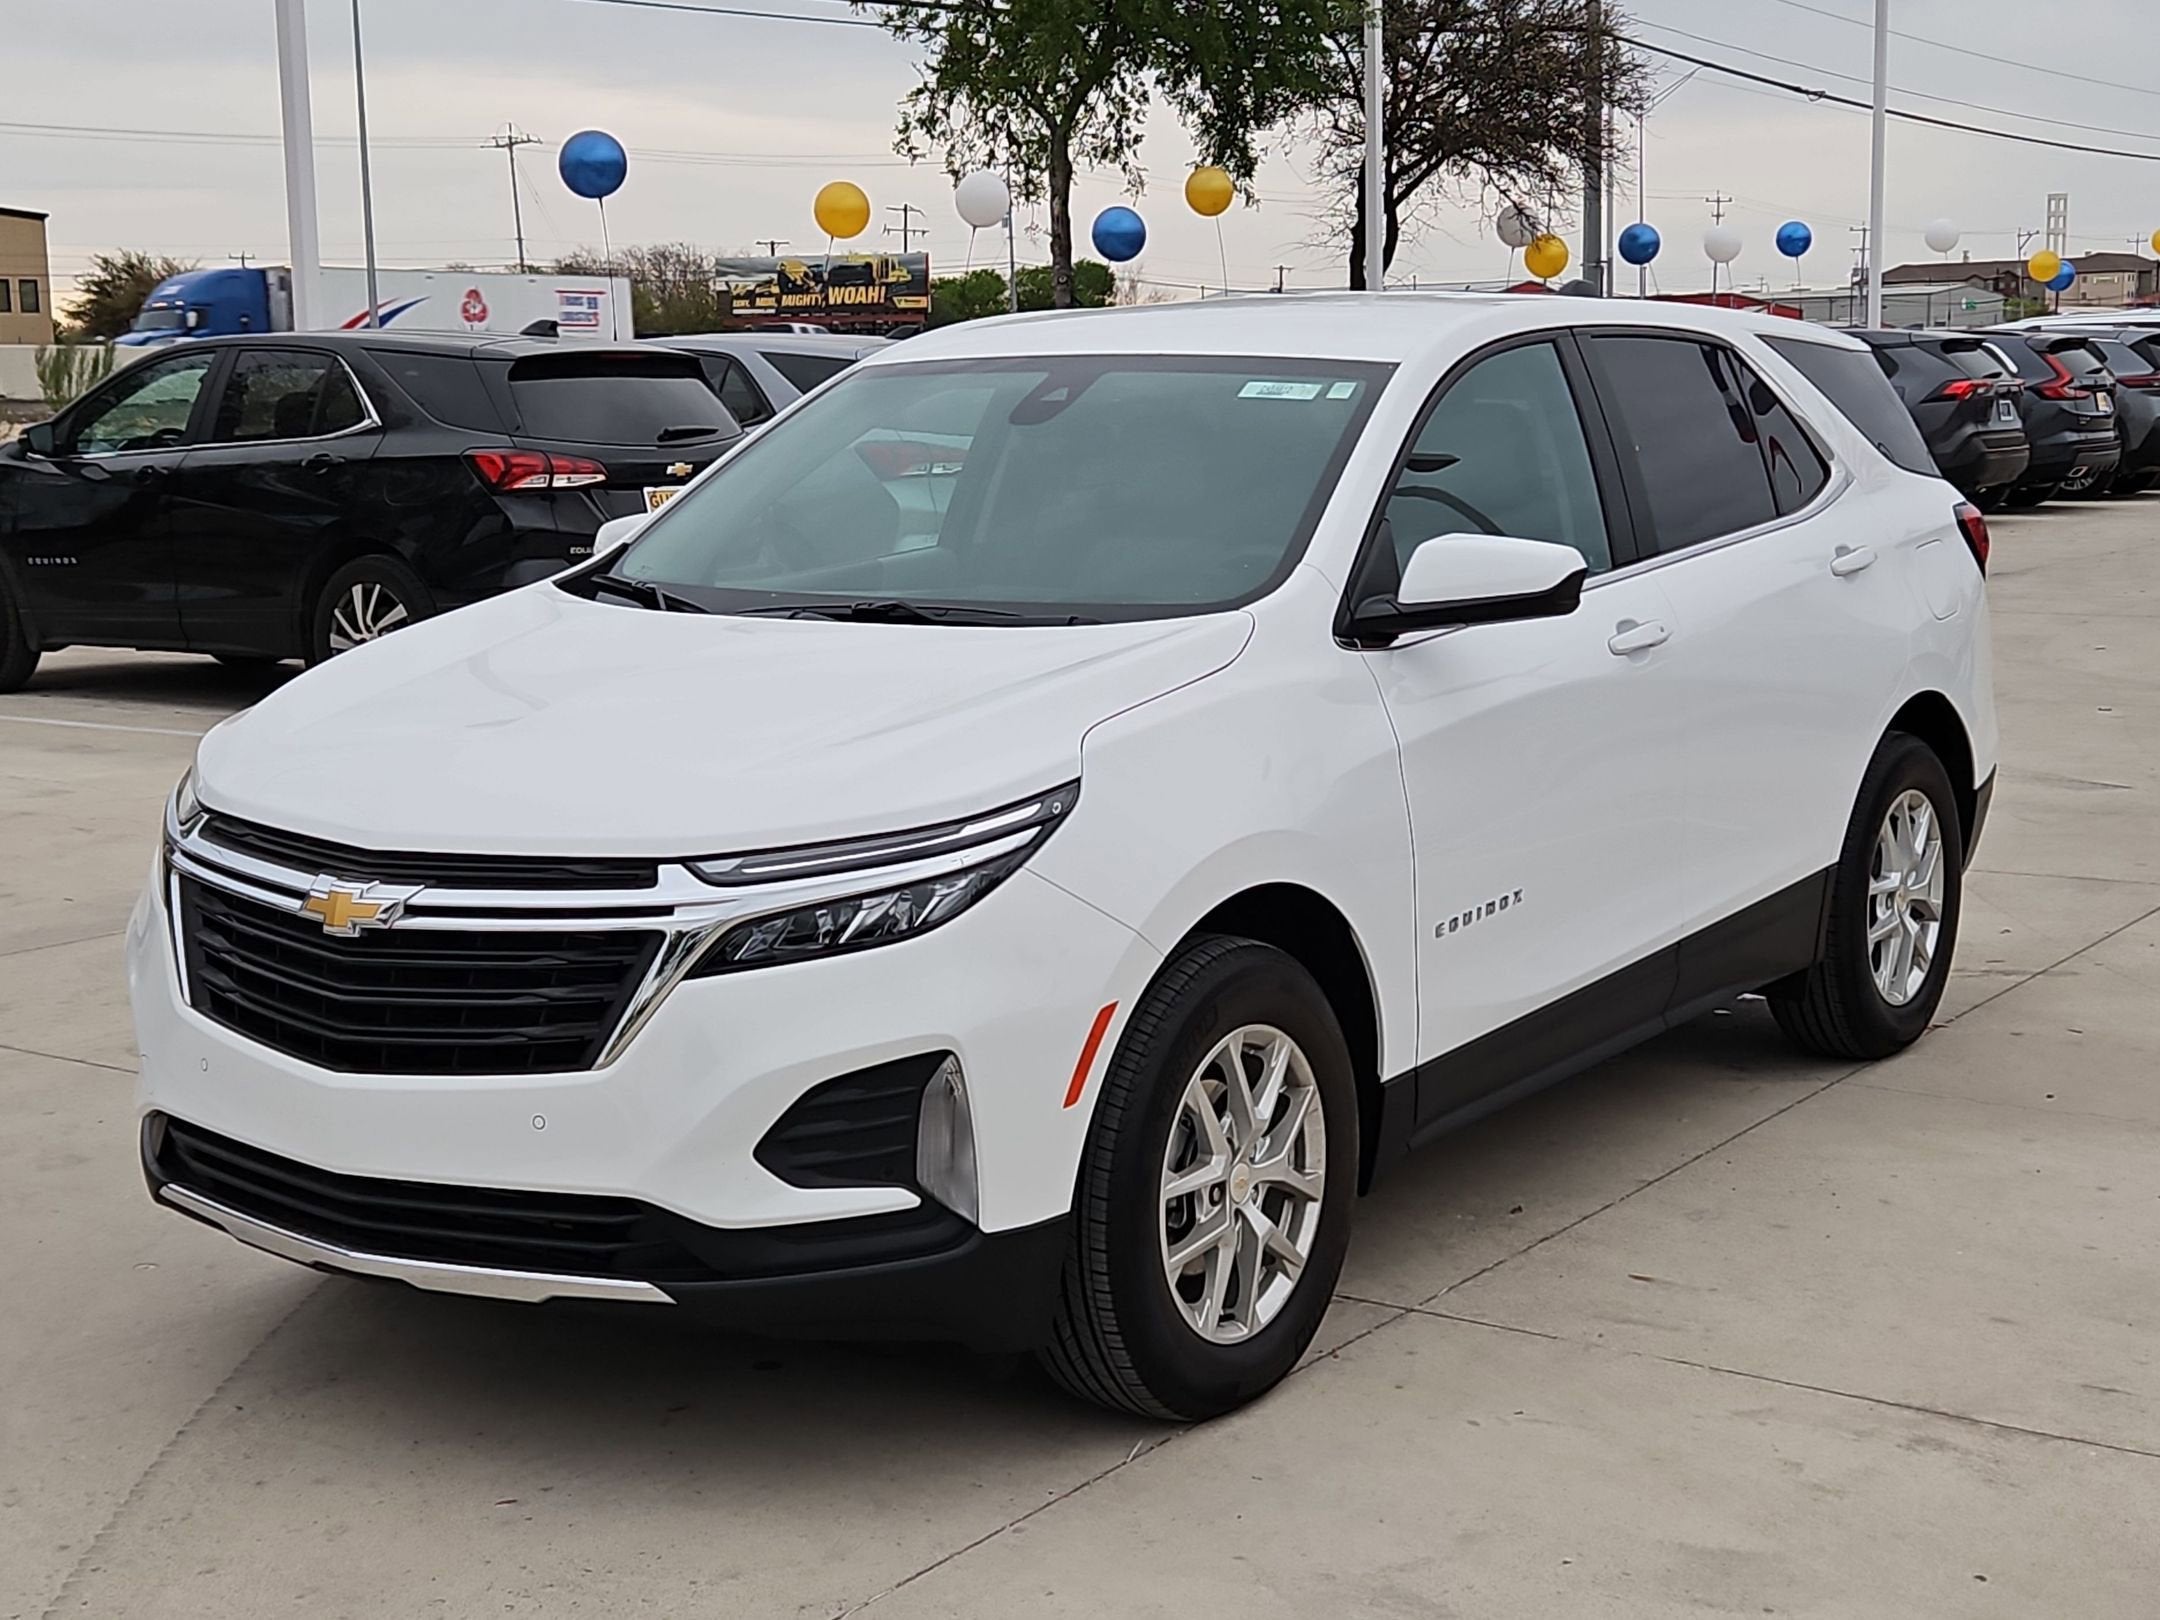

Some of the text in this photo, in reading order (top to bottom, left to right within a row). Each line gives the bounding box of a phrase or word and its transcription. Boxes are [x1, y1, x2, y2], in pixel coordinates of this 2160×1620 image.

[781, 293, 826, 309] MIGHTY,
[828, 286, 887, 305] WOAH!
[1434, 888, 1524, 940] EQUINOX
